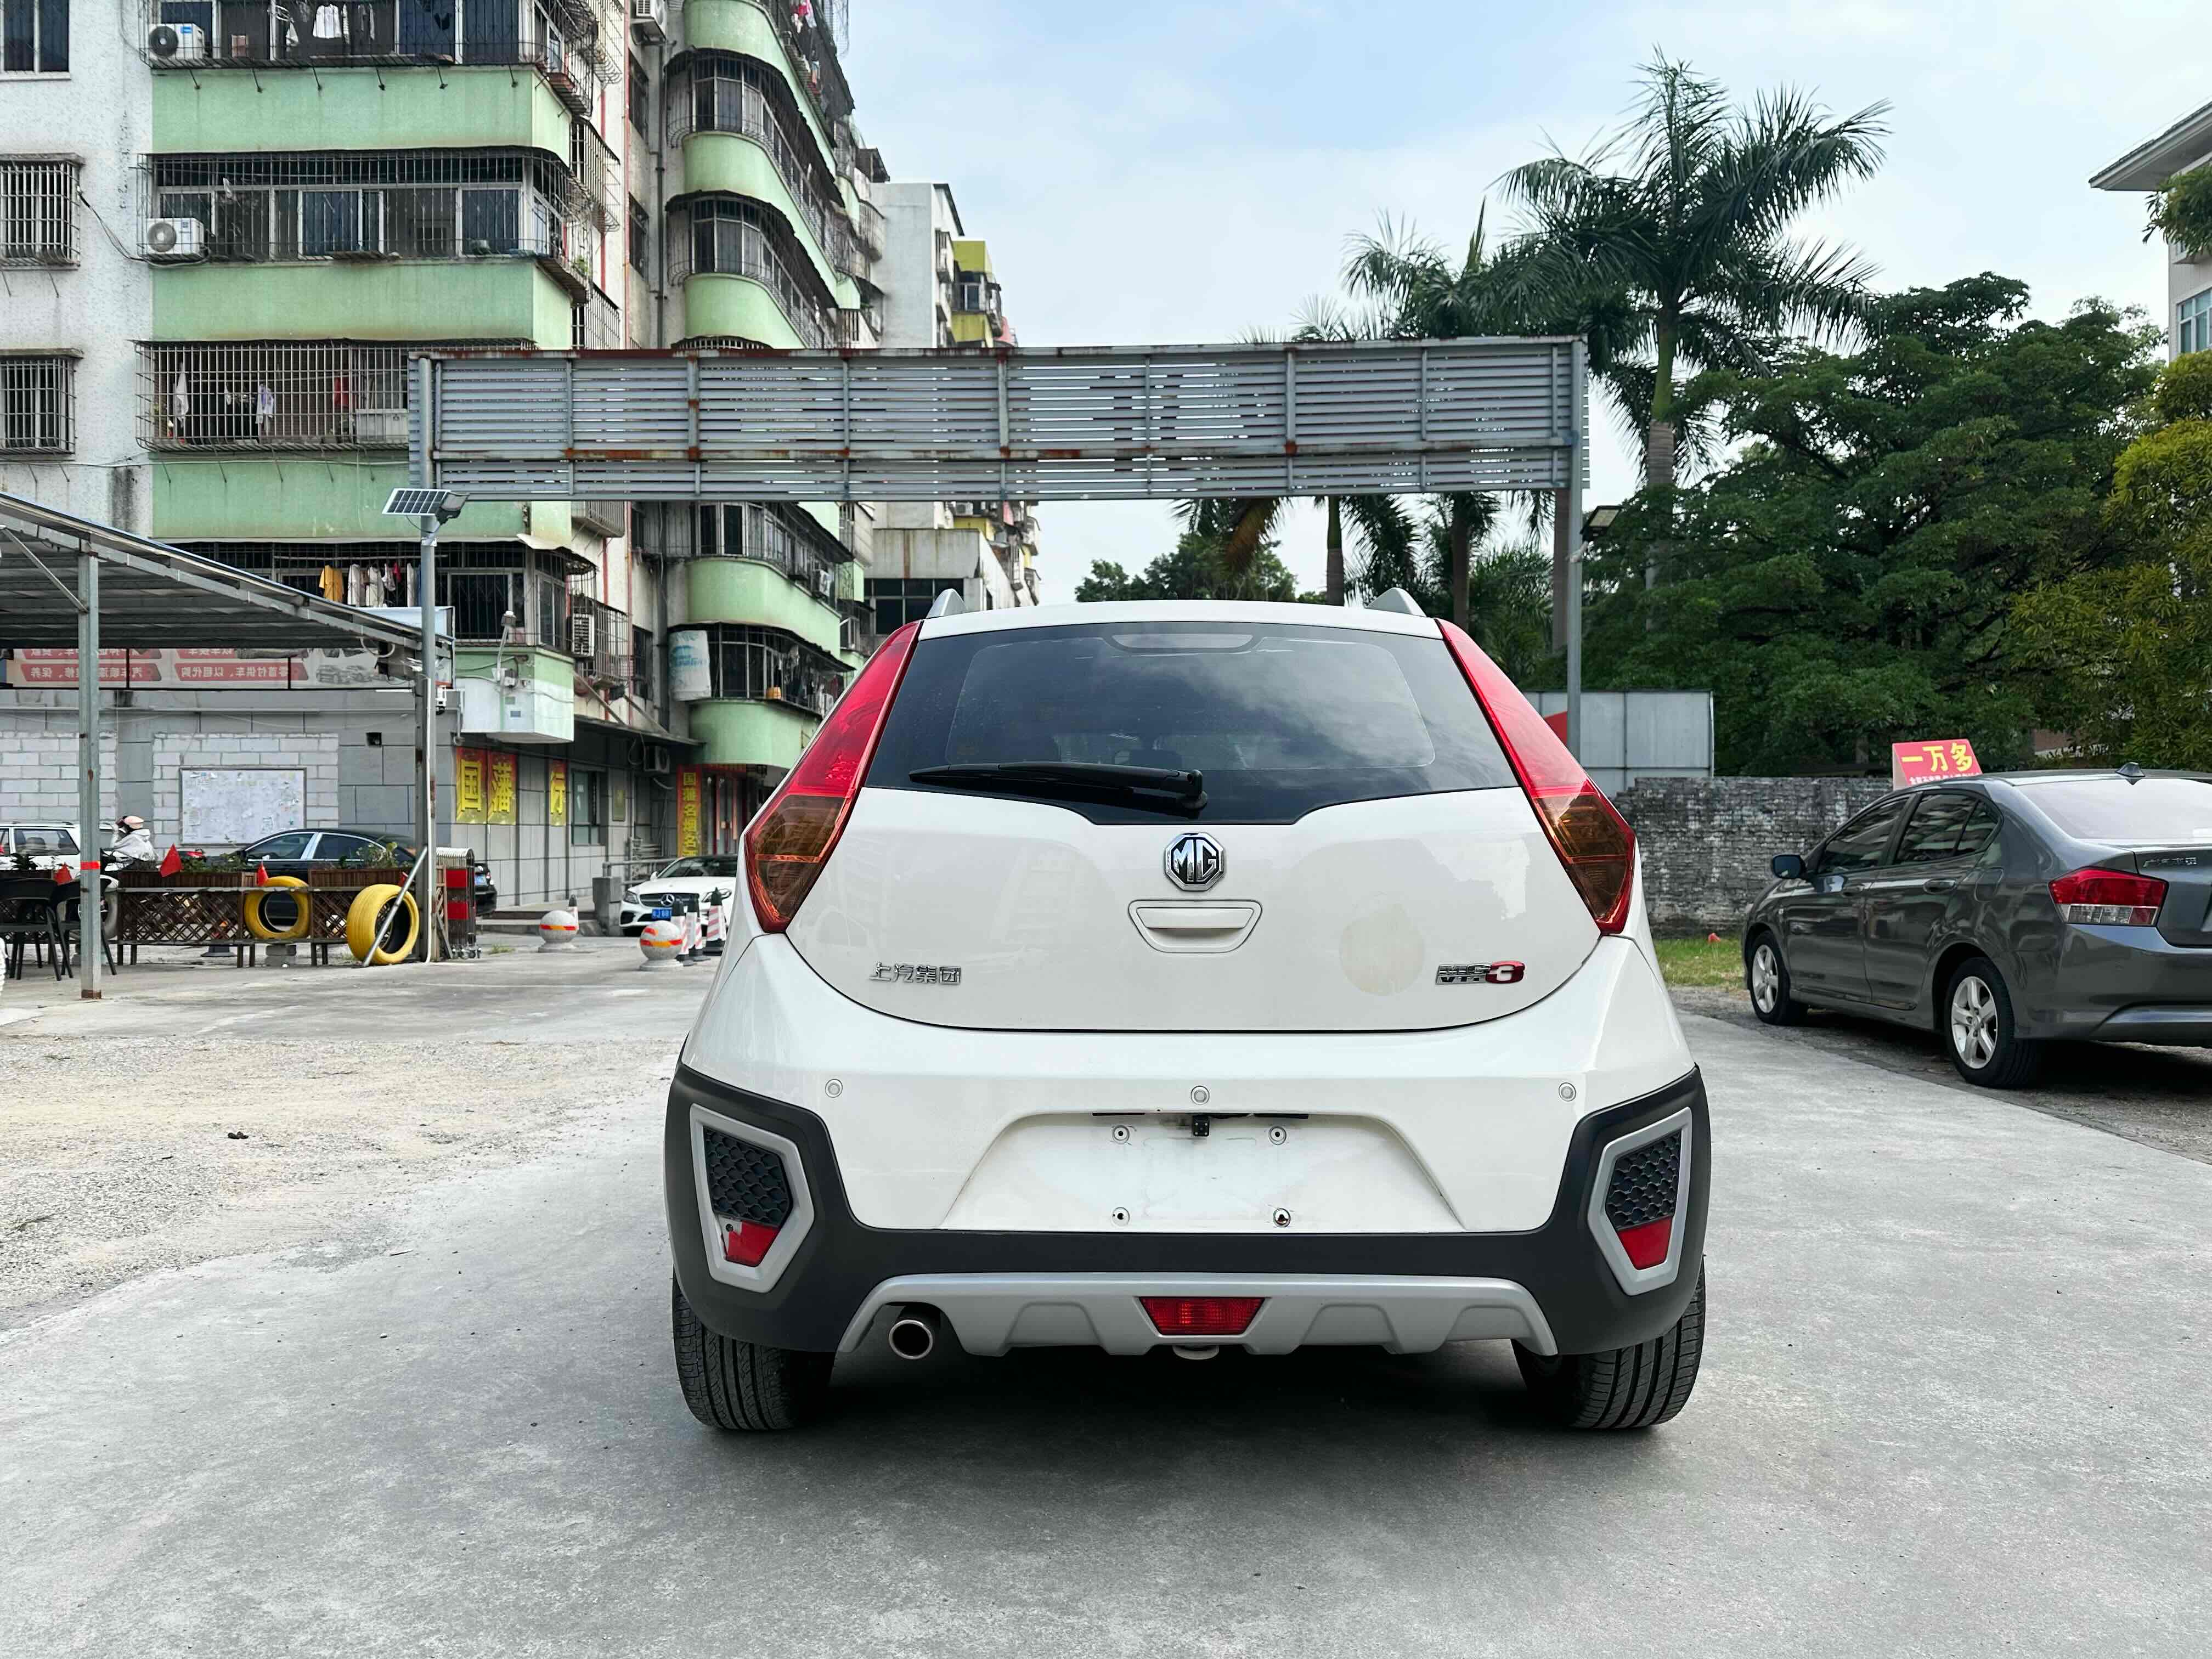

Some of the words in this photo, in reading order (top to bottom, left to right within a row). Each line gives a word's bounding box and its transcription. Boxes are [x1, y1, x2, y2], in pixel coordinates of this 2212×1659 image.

[1901, 742, 1973, 772] 一万多
[1173, 839, 1217, 882] MG
[868, 961, 961, 985] 上汽集团
